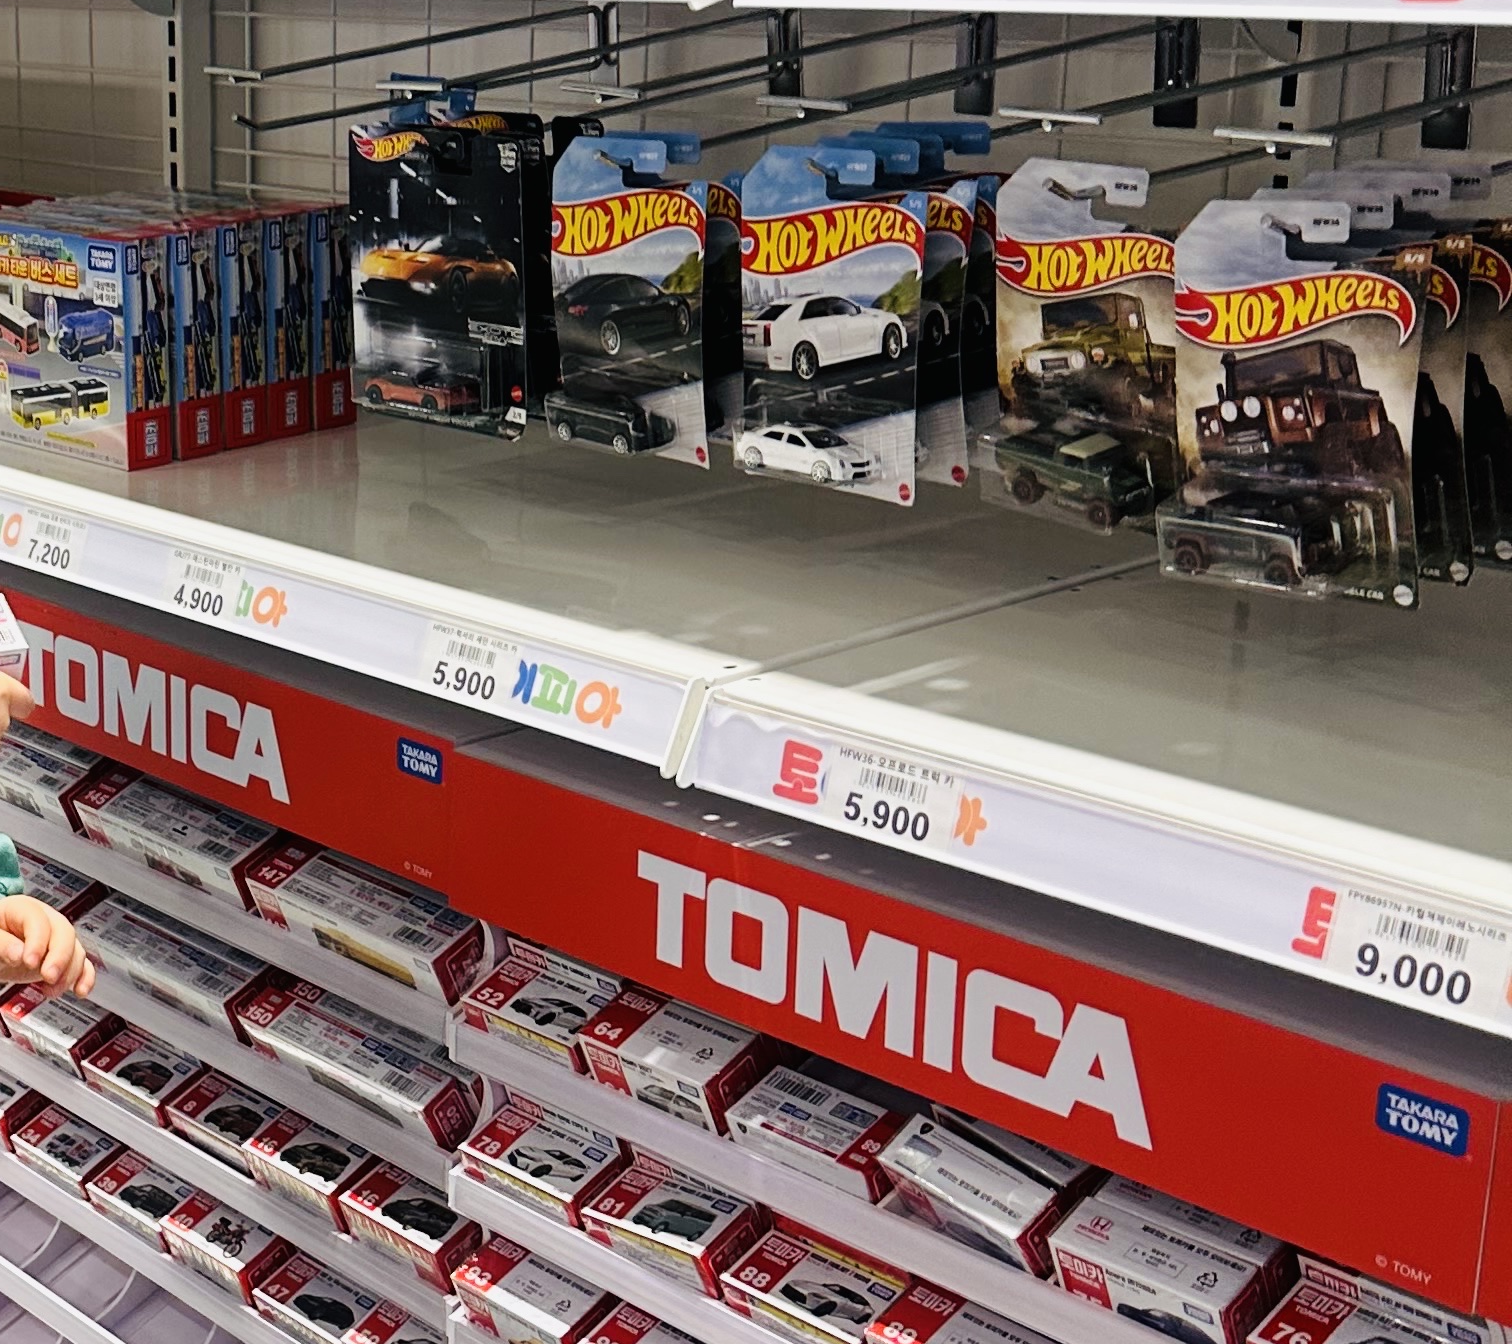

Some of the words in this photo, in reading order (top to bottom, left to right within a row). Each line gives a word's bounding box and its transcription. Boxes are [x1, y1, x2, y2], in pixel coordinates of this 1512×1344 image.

[609, 193, 701, 250] WHEELS
[759, 216, 816, 275] HOT
[814, 206, 918, 266] WHEELS
[29, 258, 55, 284] 버스
[54, 262, 80, 290] 세트
[89, 257, 115, 271] TOMY
[1021, 245, 1084, 293] HOT
[1208, 292, 1276, 345] HOT
[1277, 277, 1402, 337] WHEELS
[28, 538, 71, 570] 7,200
[173, 583, 224, 617] 4,900
[432, 659, 496, 701] 5,900
[400, 743, 439, 768] TAKARA
[401, 756, 438, 779] TOMY
[921, 767, 942, 783] 트럭
[943, 775, 955, 789] 카
[843, 791, 930, 843] 5,900
[257, 863, 286, 883] 147
[1355, 942, 1472, 1005] 9,000
[292, 981, 321, 1002] 150
[475, 988, 505, 1007] 52
[636, 848, 1153, 1152] TOMICA
[243, 1003, 273, 1026] 150
[594, 1021, 621, 1042] 64
[1386, 1090, 1460, 1131] TAKARA
[21, 1126, 40, 1143] 34
[1385, 1107, 1459, 1147] TOMY
[472, 1135, 500, 1155] 78
[97, 1175, 117, 1193] 39
[598, 1197, 625, 1216] 81
[766, 1236, 808, 1261] 토미카
[740, 1265, 772, 1287] 88
[1391, 1259, 1433, 1286] TOMY
[267, 1283, 289, 1299] 47
[908, 1284, 958, 1316] 토미카
[1294, 1287, 1353, 1321] 토미카
[619, 1306, 655, 1331] 토미카
